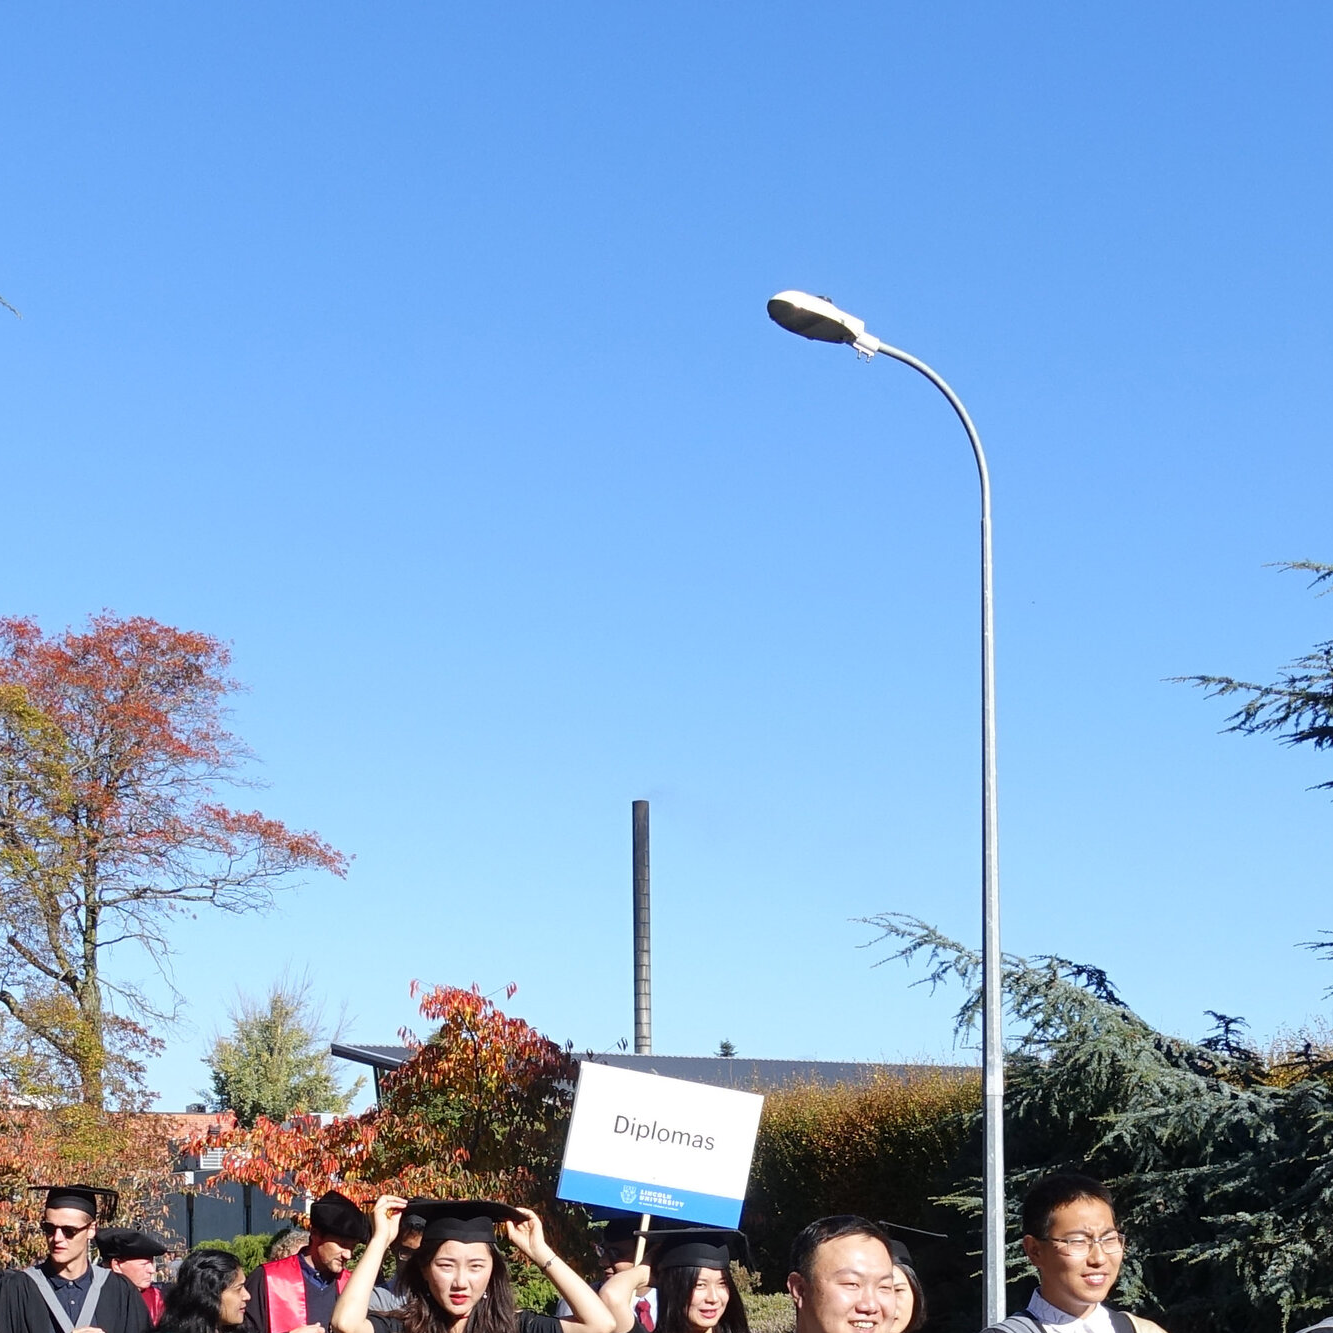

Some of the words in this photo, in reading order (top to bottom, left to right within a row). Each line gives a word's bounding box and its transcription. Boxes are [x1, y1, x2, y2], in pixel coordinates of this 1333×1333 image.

[613, 1115, 715, 1151] Diplomas
[640, 1189, 672, 1200] LINCOLN
[639, 1195, 685, 1209] UNIVERSITY
